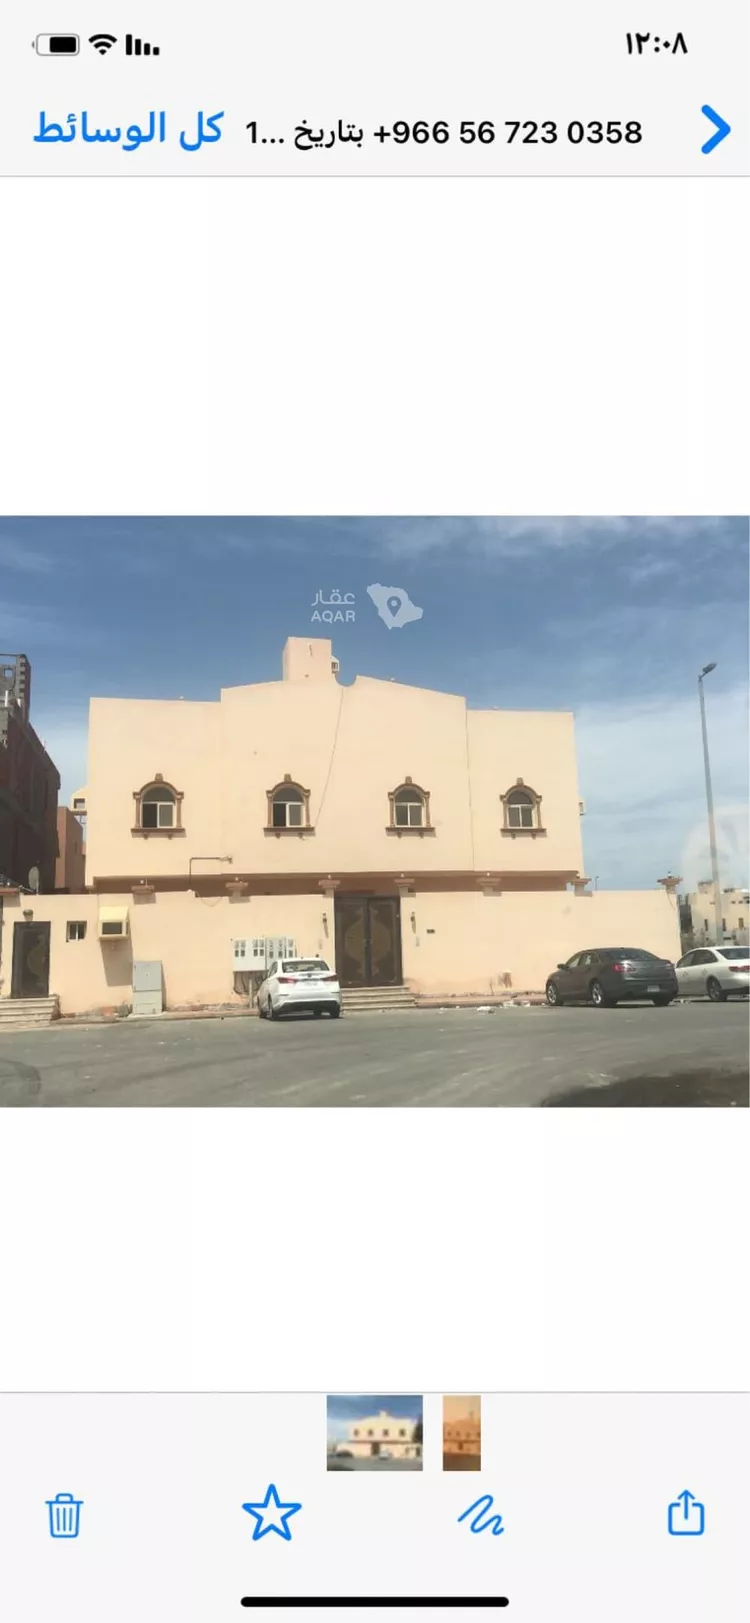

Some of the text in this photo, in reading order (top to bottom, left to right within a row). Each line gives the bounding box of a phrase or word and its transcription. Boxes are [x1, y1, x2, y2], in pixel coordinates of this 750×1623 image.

[625, 31, 689, 56] ١٢:٠٨
[32, 110, 225, 152] كل الوسائط
[293, 118, 364, 151] بتاريخ
[373, 120, 450, 145] +966
[459, 120, 496, 145] 56
[504, 120, 558, 145] 723
[566, 120, 643, 145] 0358
